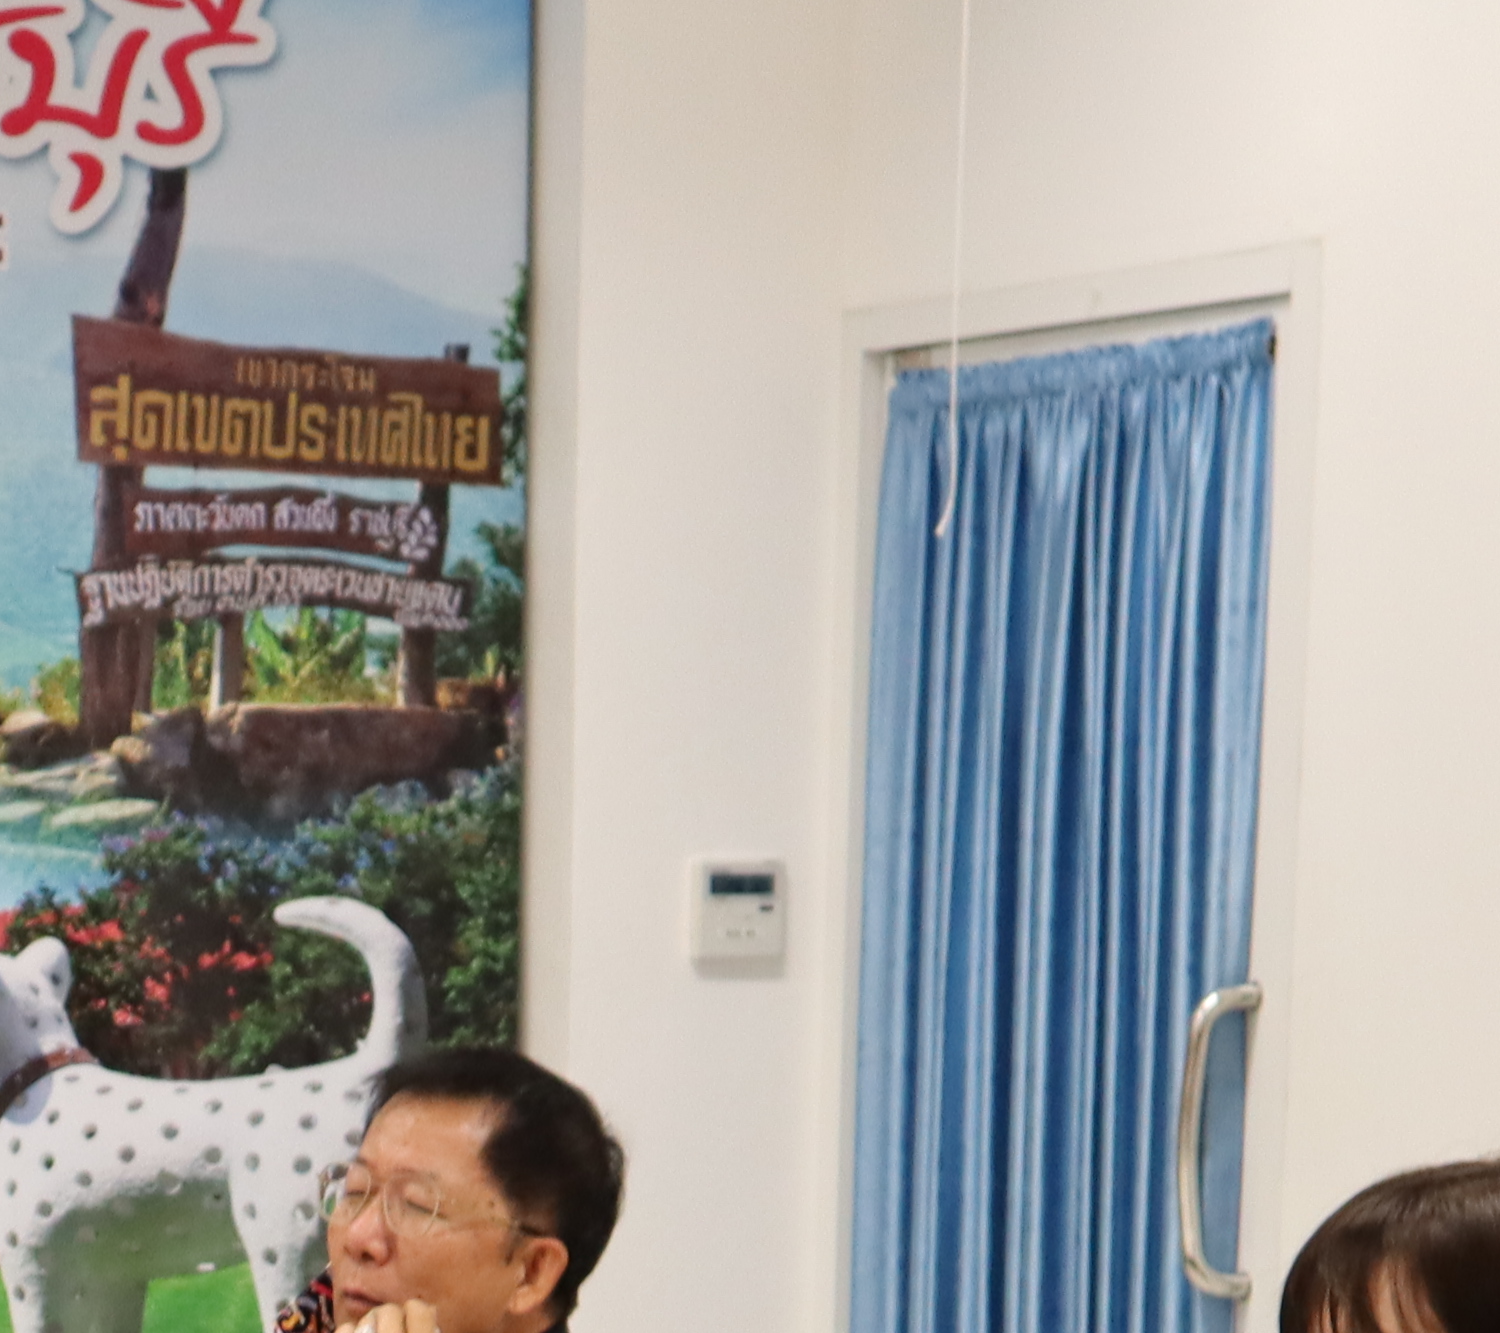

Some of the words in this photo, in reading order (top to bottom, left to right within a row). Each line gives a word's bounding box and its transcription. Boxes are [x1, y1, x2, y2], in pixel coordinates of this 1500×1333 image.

[87, 374, 490, 472] สุดเขตประเทศไทย
